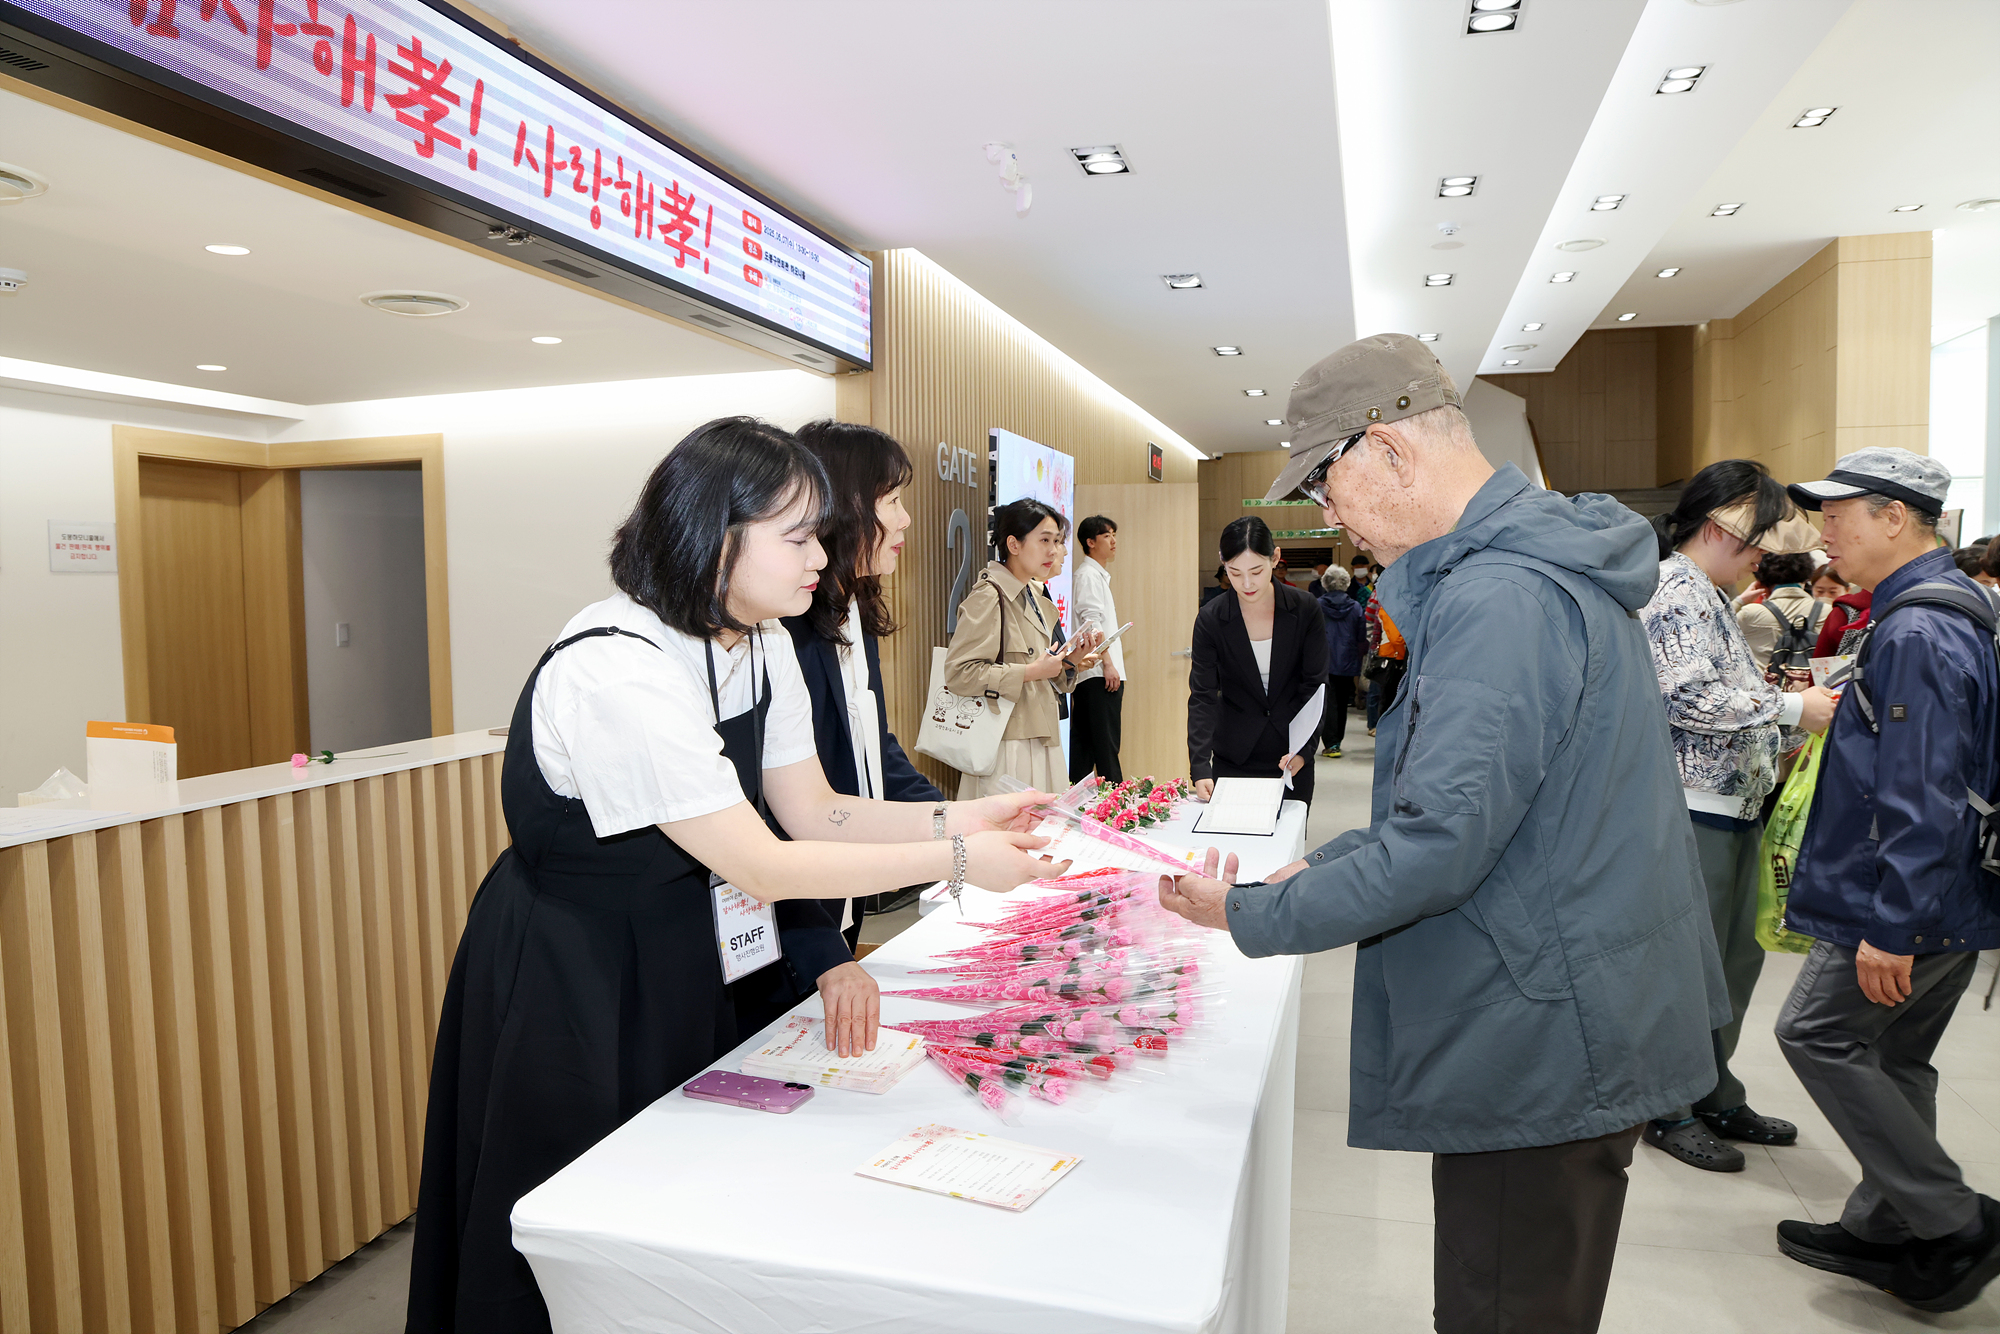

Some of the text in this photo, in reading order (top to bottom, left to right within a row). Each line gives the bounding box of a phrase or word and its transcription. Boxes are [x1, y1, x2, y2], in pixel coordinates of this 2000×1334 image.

[513, 120, 713, 275] 사랑해孝!
[938, 442, 977, 489] GATE
[947, 508, 971, 634] 2
[730, 925, 765, 951] STAFF
[735, 943, 765, 962] 행사진행요원
